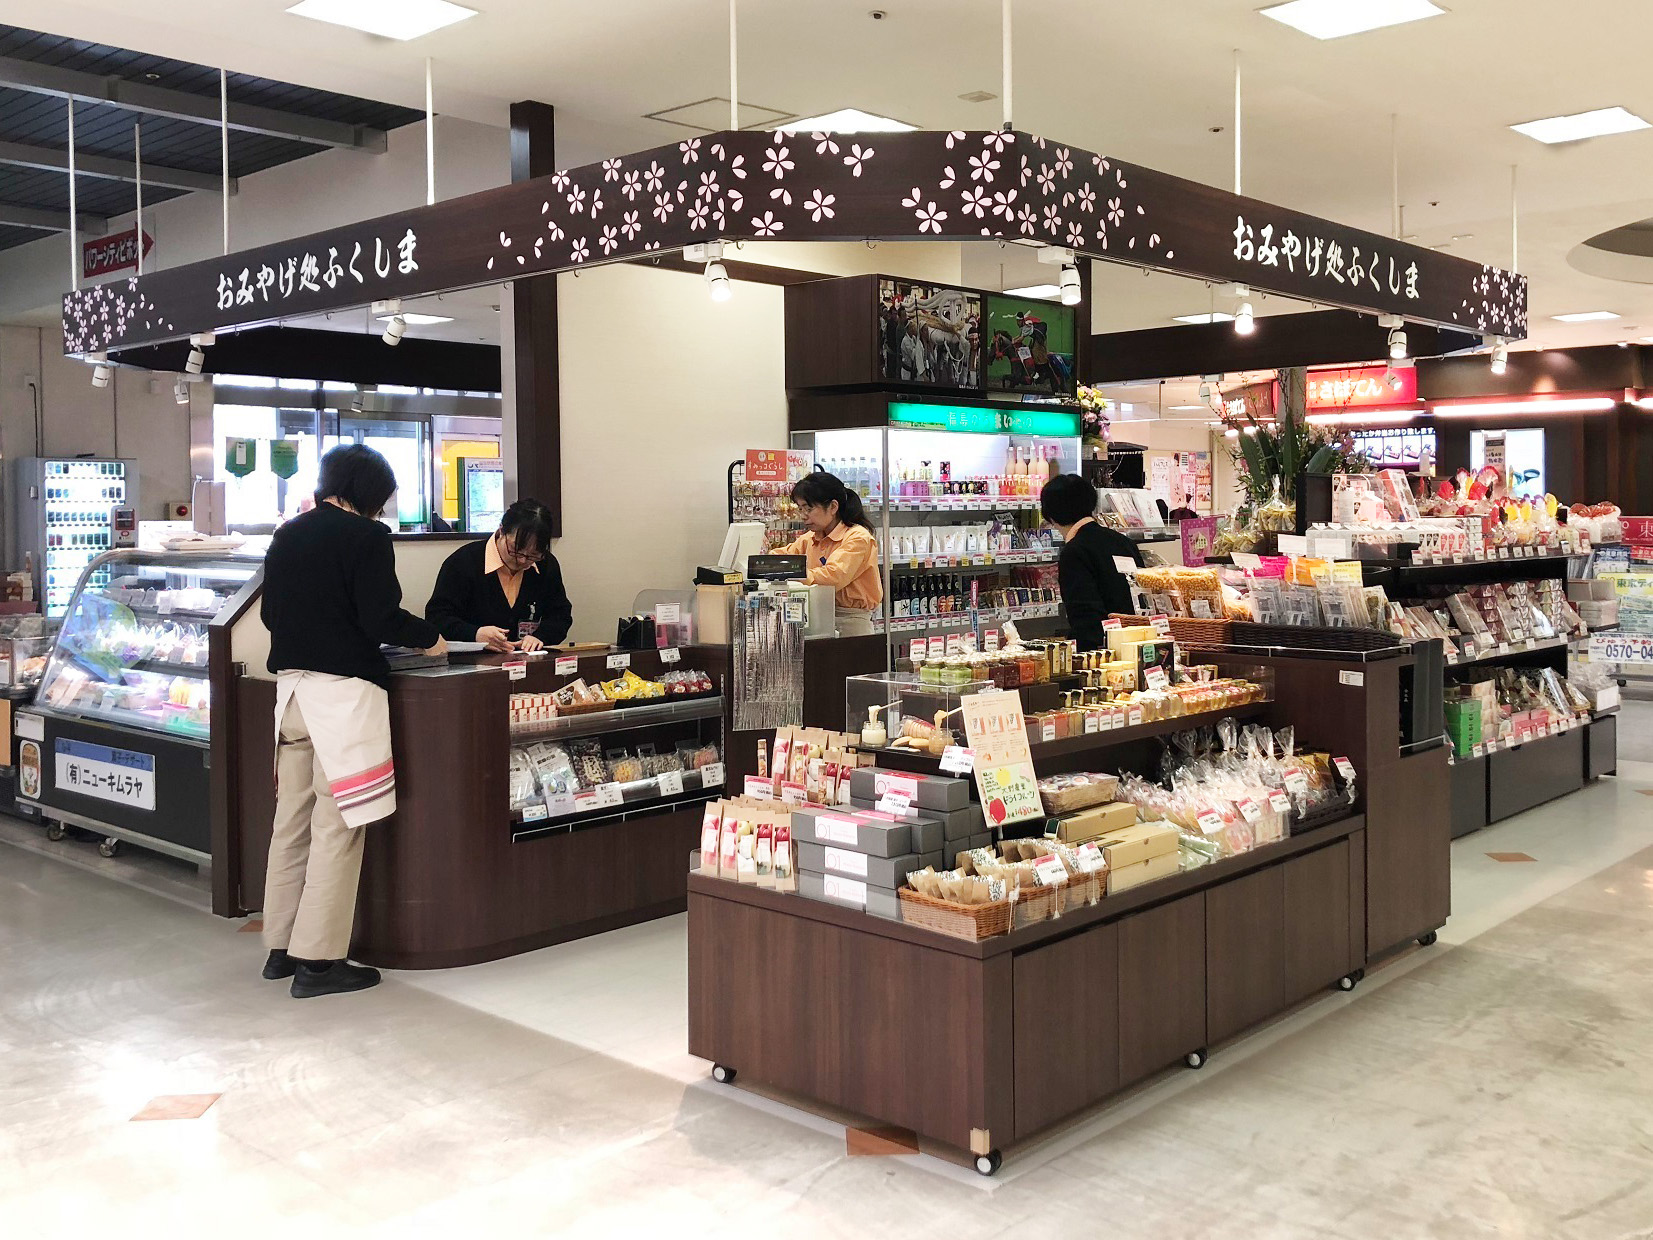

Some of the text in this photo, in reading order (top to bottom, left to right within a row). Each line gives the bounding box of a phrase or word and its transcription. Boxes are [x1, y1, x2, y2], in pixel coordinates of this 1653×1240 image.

[216, 229, 419, 310] おみやげ処ふくしま
[1233, 216, 1419, 298] おみやげ処ふくしま
[66, 763, 143, 798] (有)ニューキムラヤ
